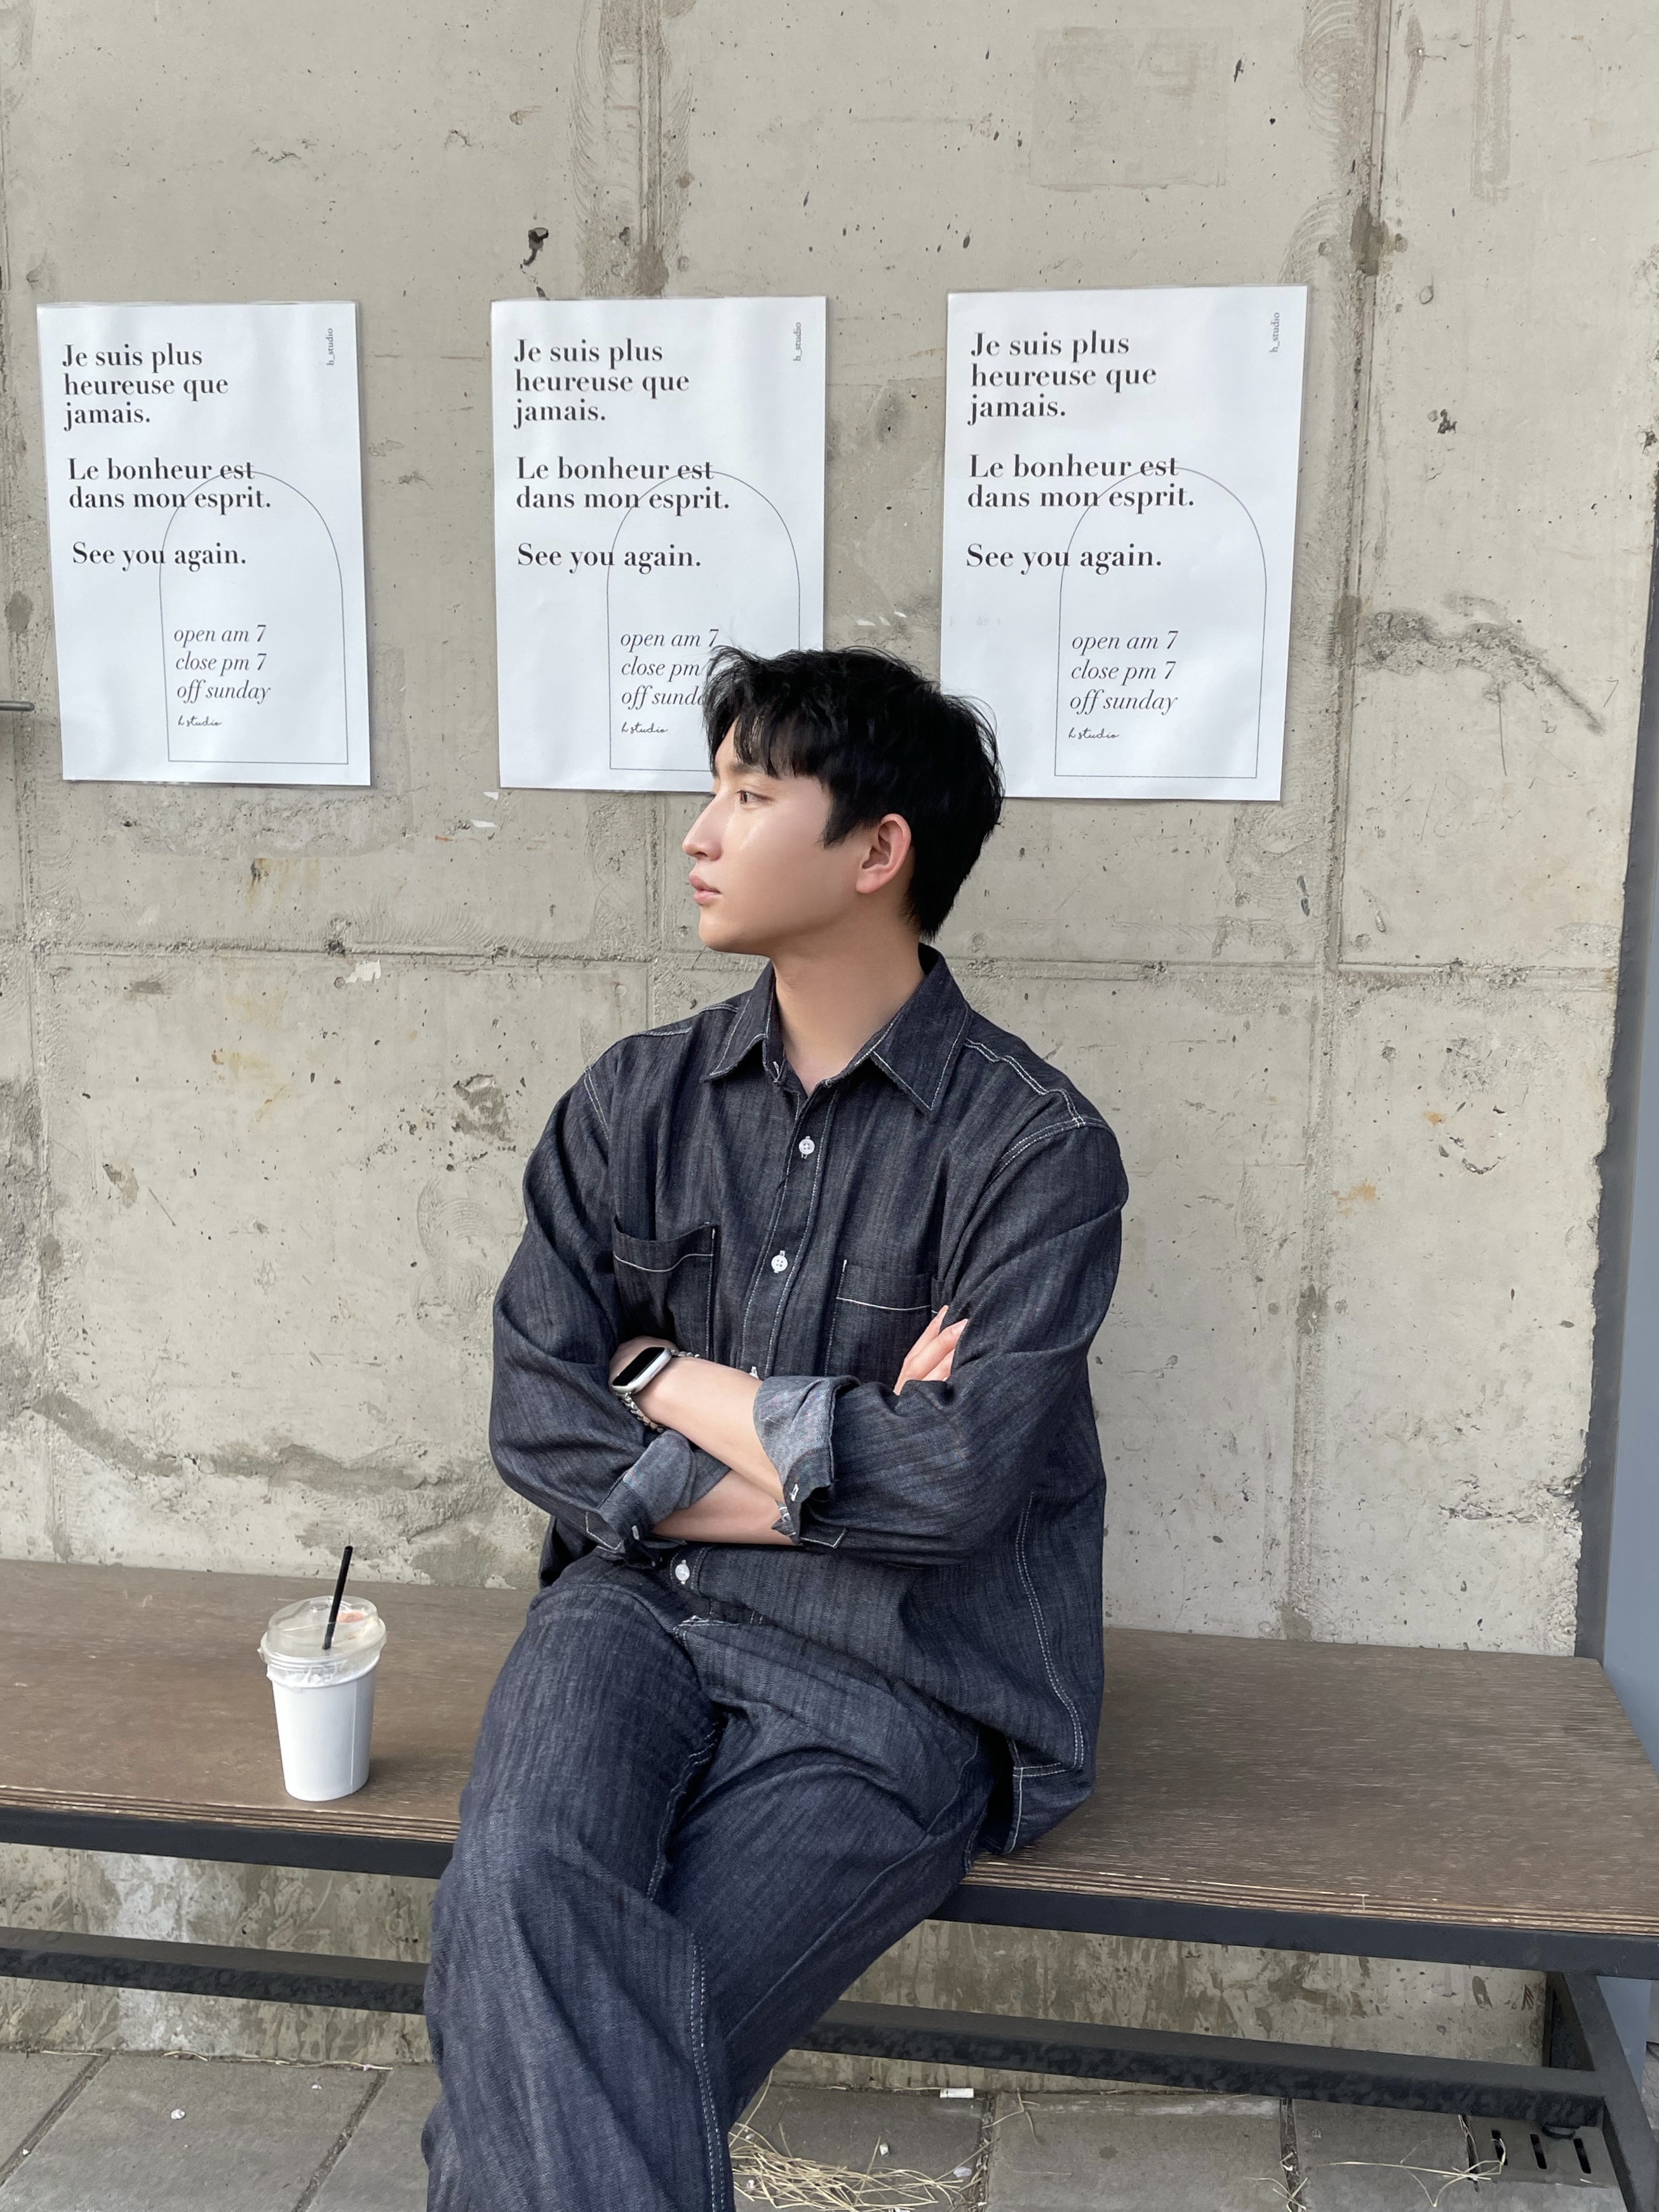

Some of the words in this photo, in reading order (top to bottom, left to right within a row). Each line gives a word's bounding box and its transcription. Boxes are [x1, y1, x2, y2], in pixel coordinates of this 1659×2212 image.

[325, 328, 335, 365] h_studio
[793, 322, 802, 361] h_studio
[971, 332, 1000, 356] Je
[1009, 331, 1061, 356] suis
[1071, 330, 1129, 363] plus
[1269, 312, 1280, 352] h_studio
[62, 344, 88, 367] Je
[96, 344, 143, 366] suis
[151, 342, 202, 373] plus
[514, 339, 541, 363] Je
[550, 339, 600, 362] suis
[608, 338, 662, 370] plus
[64, 373, 175, 395] heureuse
[184, 379, 228, 402] que
[515, 367, 633, 392] heureuse
[642, 376, 689, 399] que
[971, 363, 1096, 387] heureuse
[1106, 368, 1157, 394] que
[64, 401, 150, 432] jamais.
[513, 398, 605, 429] jamais.
[967, 393, 1065, 426] jamais.
[67, 458, 98, 480] Le
[107, 458, 212, 479] bonheur
[220, 462, 255, 479] est
[516, 457, 549, 479] Le
[558, 457, 669, 479] bonheur
[677, 462, 713, 479] est
[969, 454, 1004, 478] Le
[1013, 453, 1131, 477] bonheur
[1140, 458, 1179, 476] est
[69, 486, 124, 508] dans
[133, 490, 186, 507] mon
[194, 486, 271, 515] esprit.
[516, 485, 575, 508] dans
[584, 490, 640, 508] mon
[649, 486, 730, 516] esprit.
[968, 484, 1030, 507] dans
[1039, 488, 1099, 507] mon
[1109, 483, 1194, 515] esprit.
[73, 541, 115, 564] See
[123, 550, 166, 572] you
[175, 542, 246, 572] again.
[518, 542, 562, 566] See
[569, 551, 615, 573] you
[624, 544, 701, 575] again.
[967, 544, 1014, 567] See
[1021, 551, 1070, 575] you
[1080, 543, 1161, 575] again.
[174, 629, 215, 648] open
[222, 629, 249, 642] am
[257, 624, 266, 642] 7
[621, 633, 665, 653] open
[671, 634, 701, 647] am
[708, 629, 719, 647] 7
[1072, 636, 1120, 656] open
[1127, 636, 1159, 649] am
[1167, 631, 1178, 649] 7
[176, 651, 217, 670] close
[219, 659, 250, 676] pm
[257, 653, 267, 671] 7
[621, 655, 665, 676] close
[668, 663, 699, 682] pm
[1071, 659, 1119, 679] close
[1120, 667, 1156, 686] pm
[1165, 661, 1176, 680] 7
[177, 679, 206, 704] off
[205, 680, 271, 704] sunday
[621, 685, 652, 709] off
[652, 686, 705, 705] sund
[1070, 689, 1105, 714] off
[1103, 689, 1178, 715] sunday
